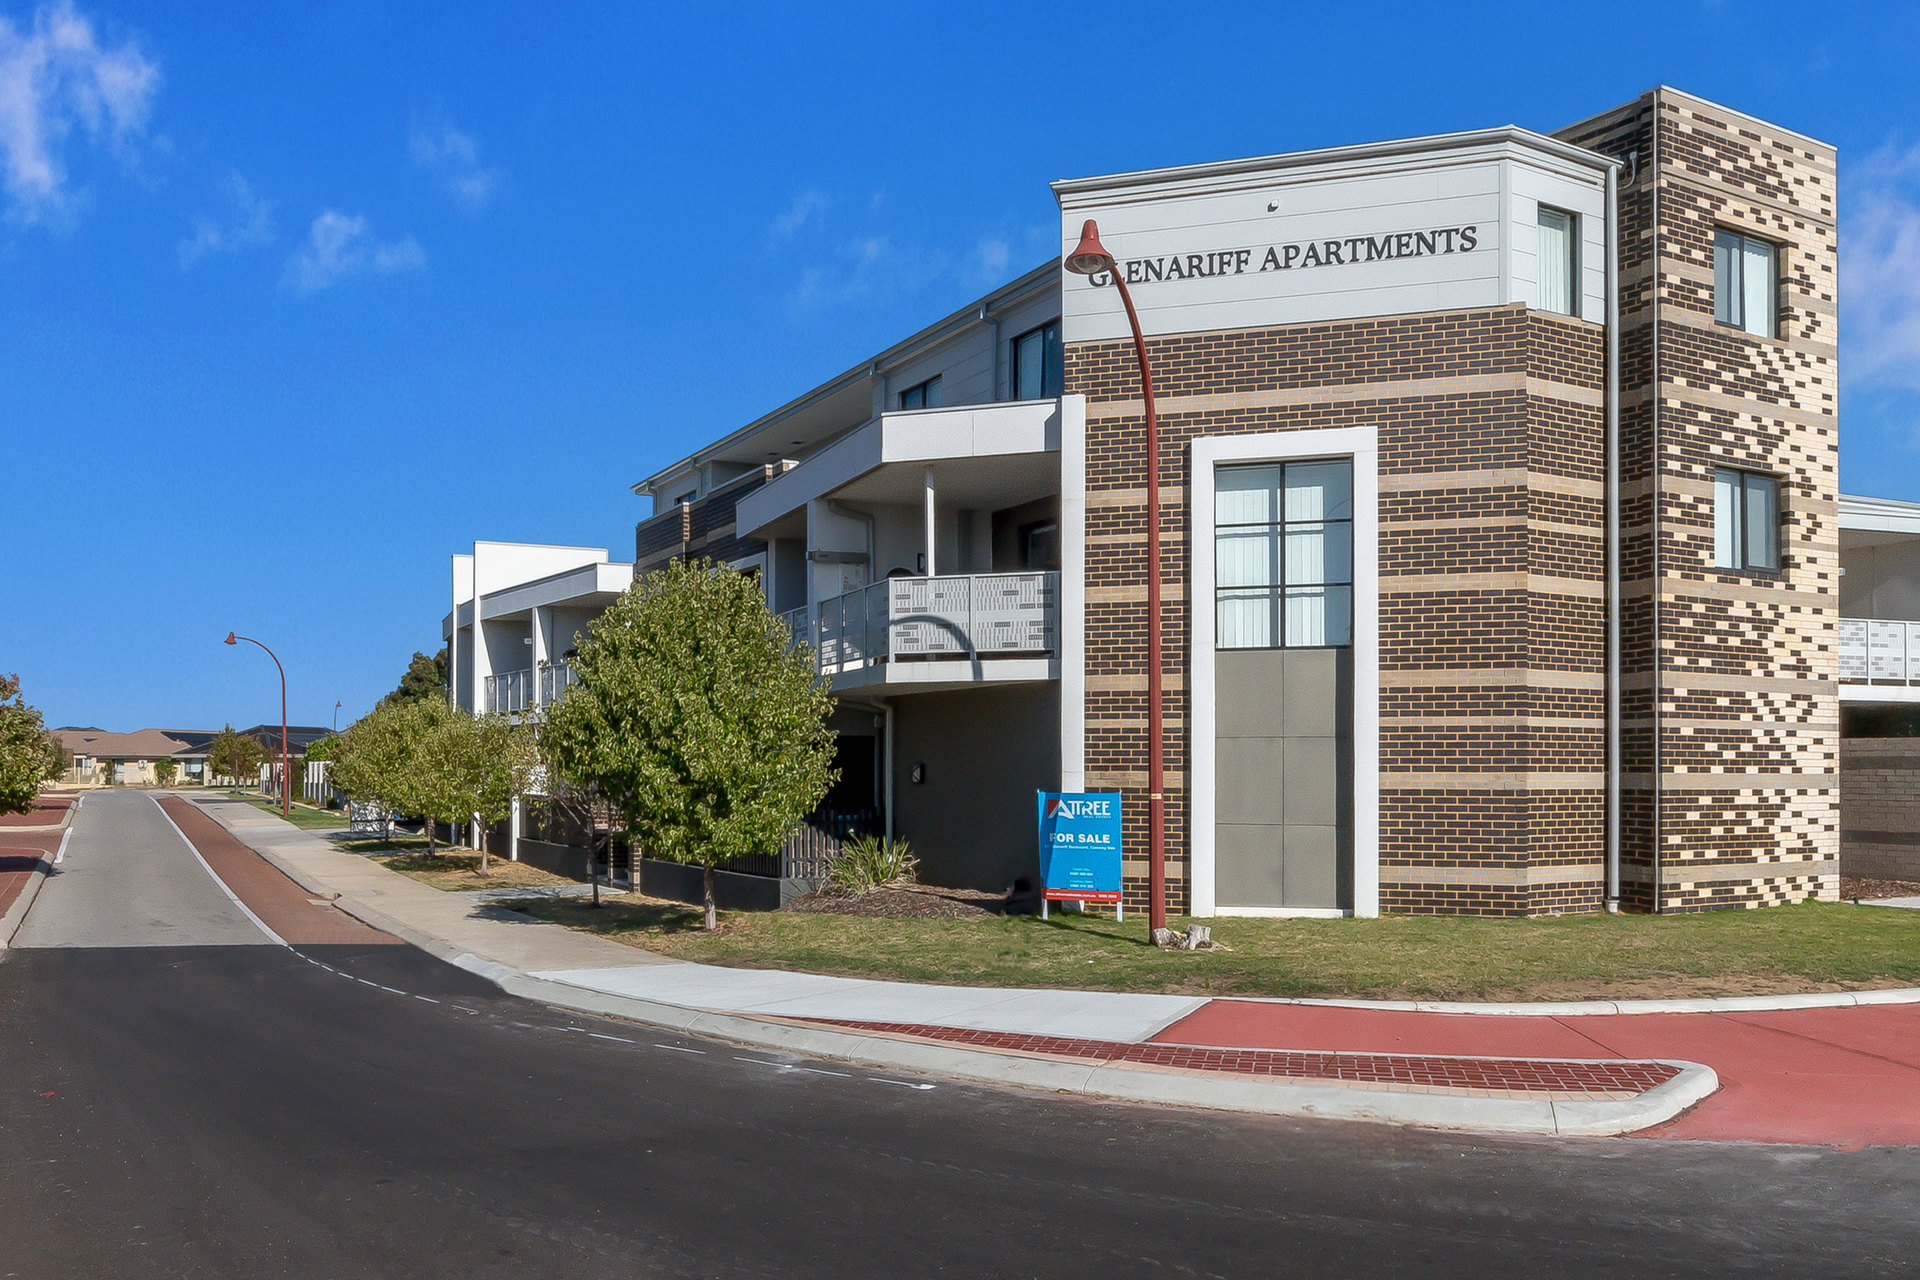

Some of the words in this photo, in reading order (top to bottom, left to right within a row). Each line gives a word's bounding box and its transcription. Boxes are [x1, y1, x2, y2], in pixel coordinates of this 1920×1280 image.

[1259, 226, 1478, 272] APARTMENTS
[1048, 799, 1111, 819] ATTREE
[1049, 833, 1074, 843] FOR
[1078, 833, 1111, 844] SALE
